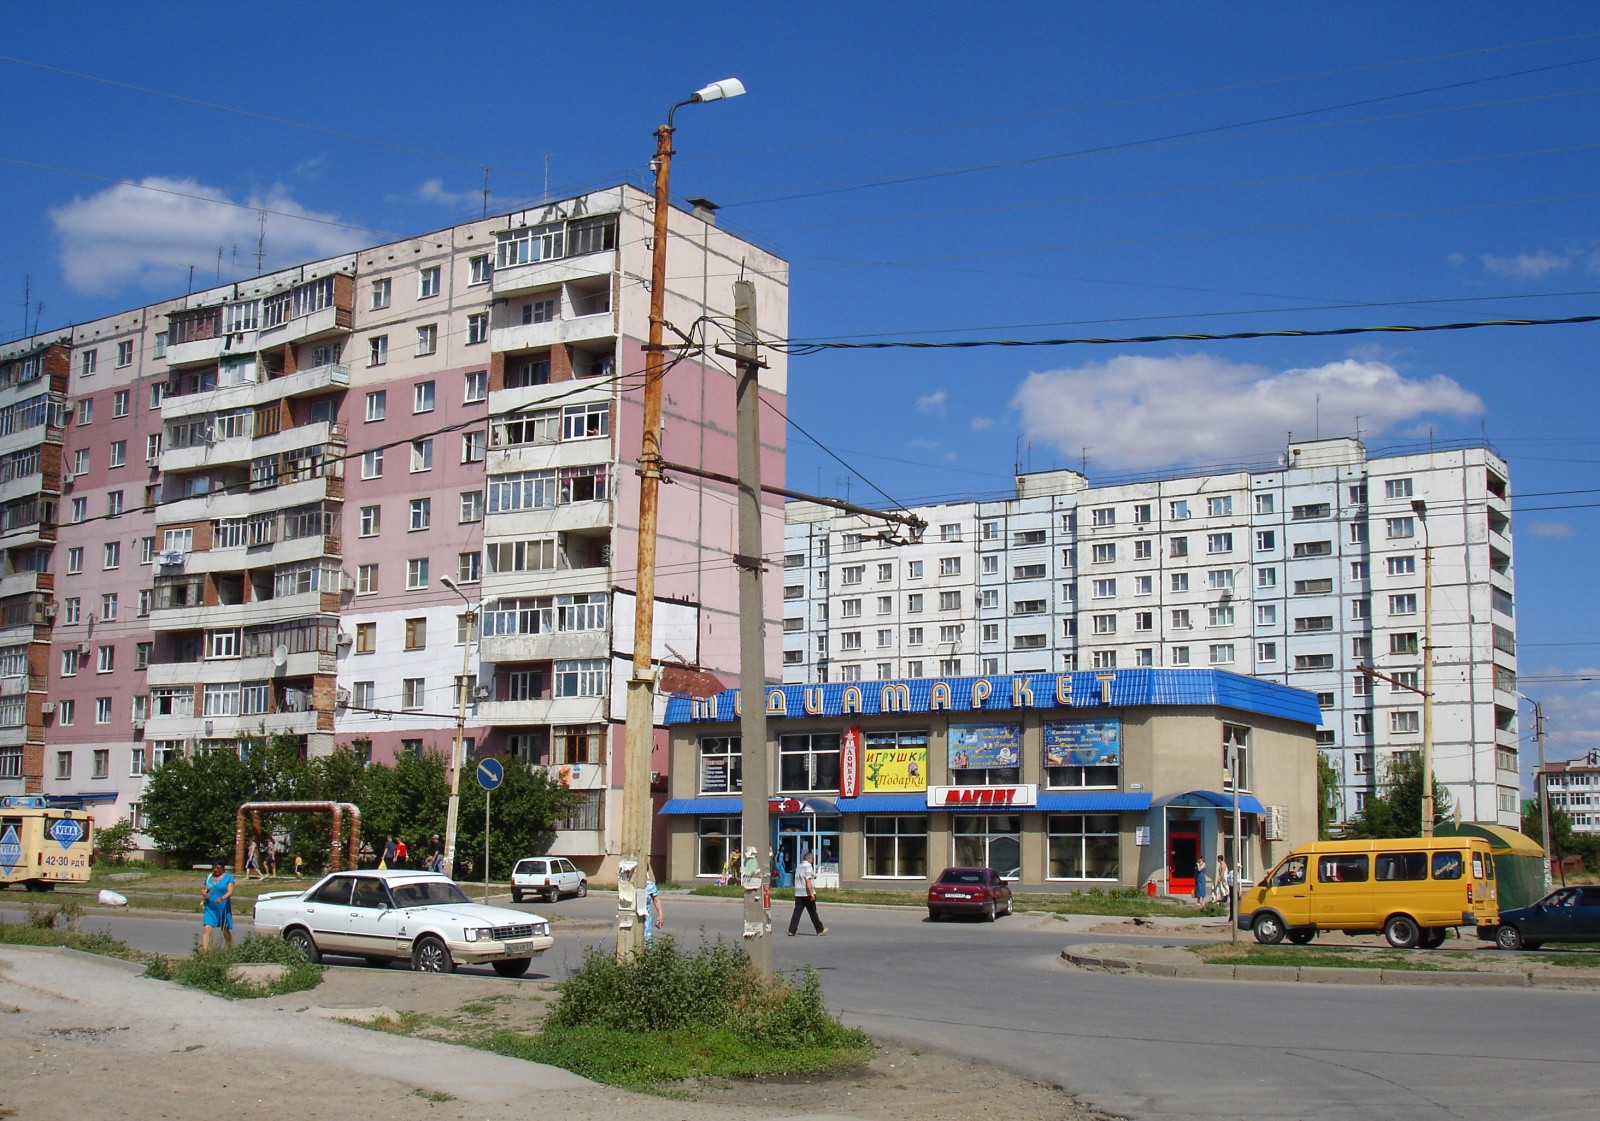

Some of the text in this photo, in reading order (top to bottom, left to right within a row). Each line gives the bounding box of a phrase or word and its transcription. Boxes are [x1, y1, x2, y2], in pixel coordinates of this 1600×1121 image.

[866, 752, 927, 763] ИГРУШКИ
[878, 773, 925, 789] Подарки
[58, 826, 76, 834] VEKA
[46, 856, 69, 866] 42-30
